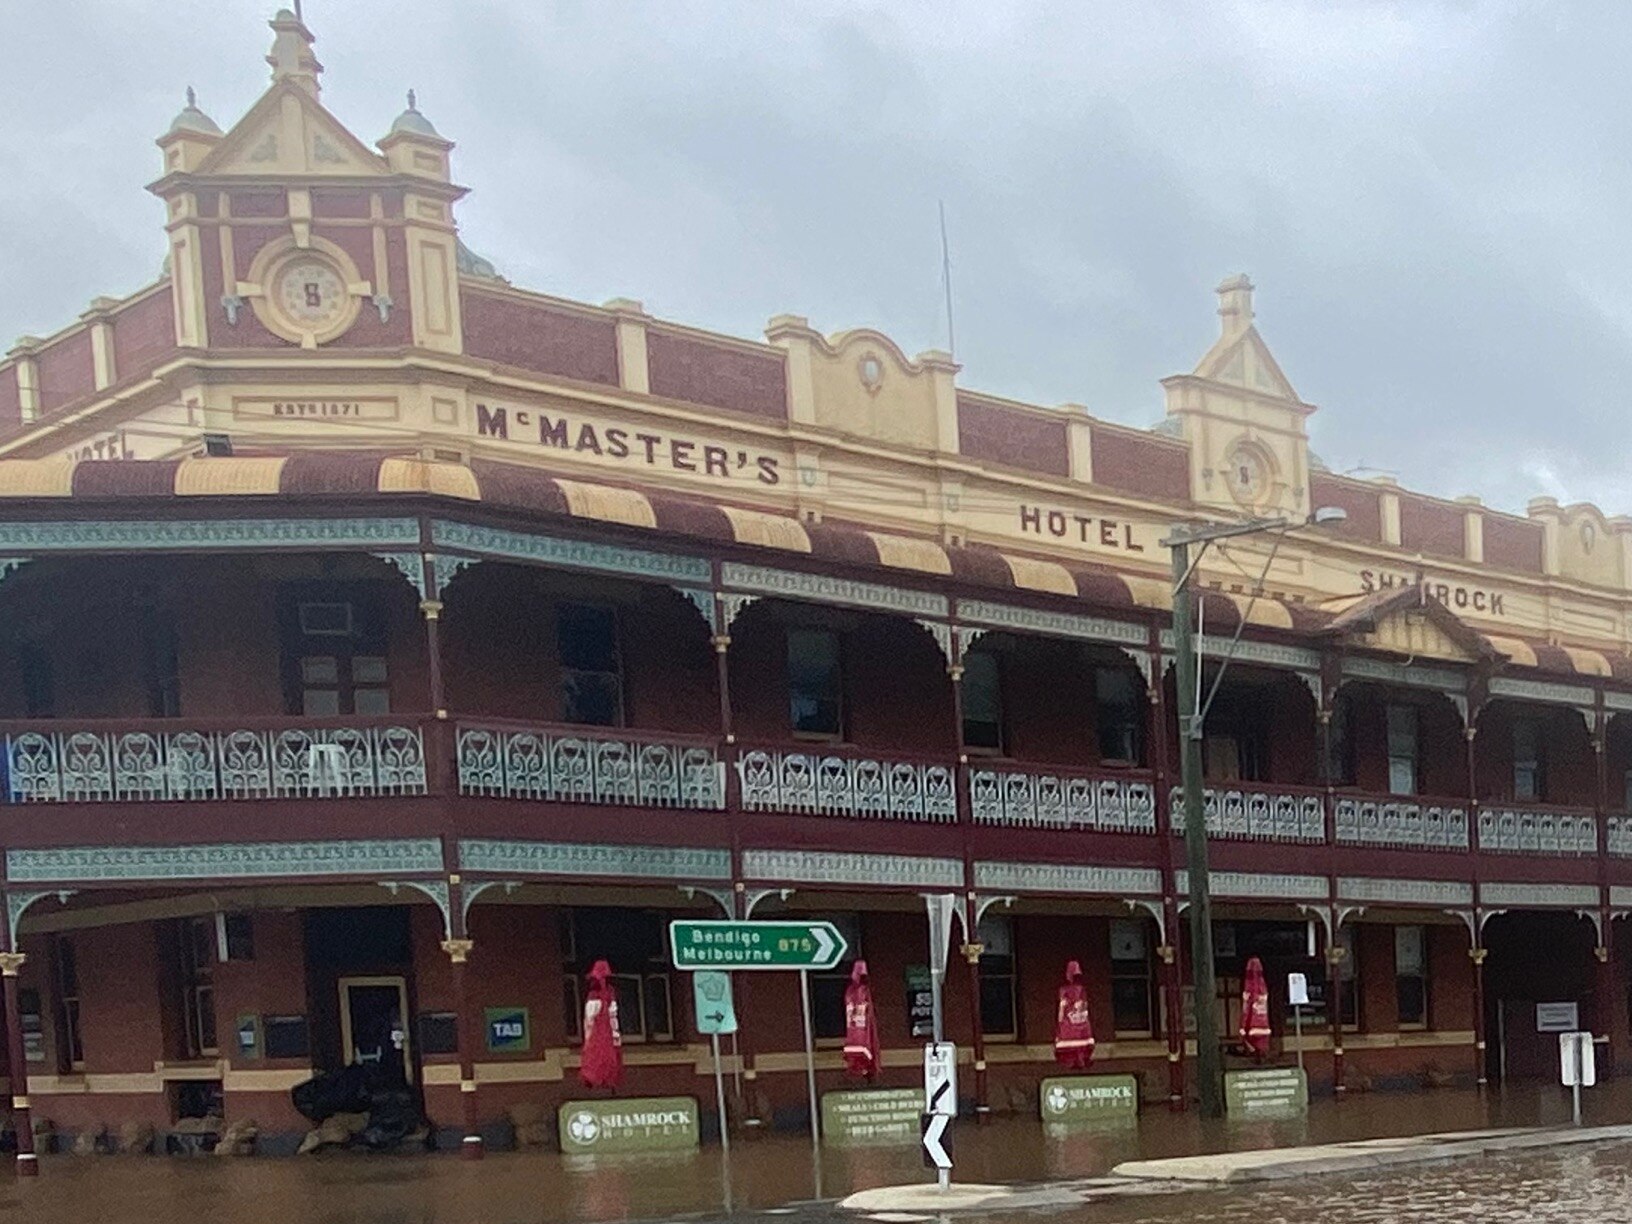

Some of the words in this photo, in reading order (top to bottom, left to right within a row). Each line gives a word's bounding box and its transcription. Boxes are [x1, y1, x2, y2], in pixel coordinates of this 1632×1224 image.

[1020, 504, 1144, 552] HOTEL
[691, 928, 761, 947] Bendigo
[683, 947, 772, 962] Melbourne
[492, 1023, 522, 1037] TAB
[601, 1110, 691, 1128] SHAMROCK
